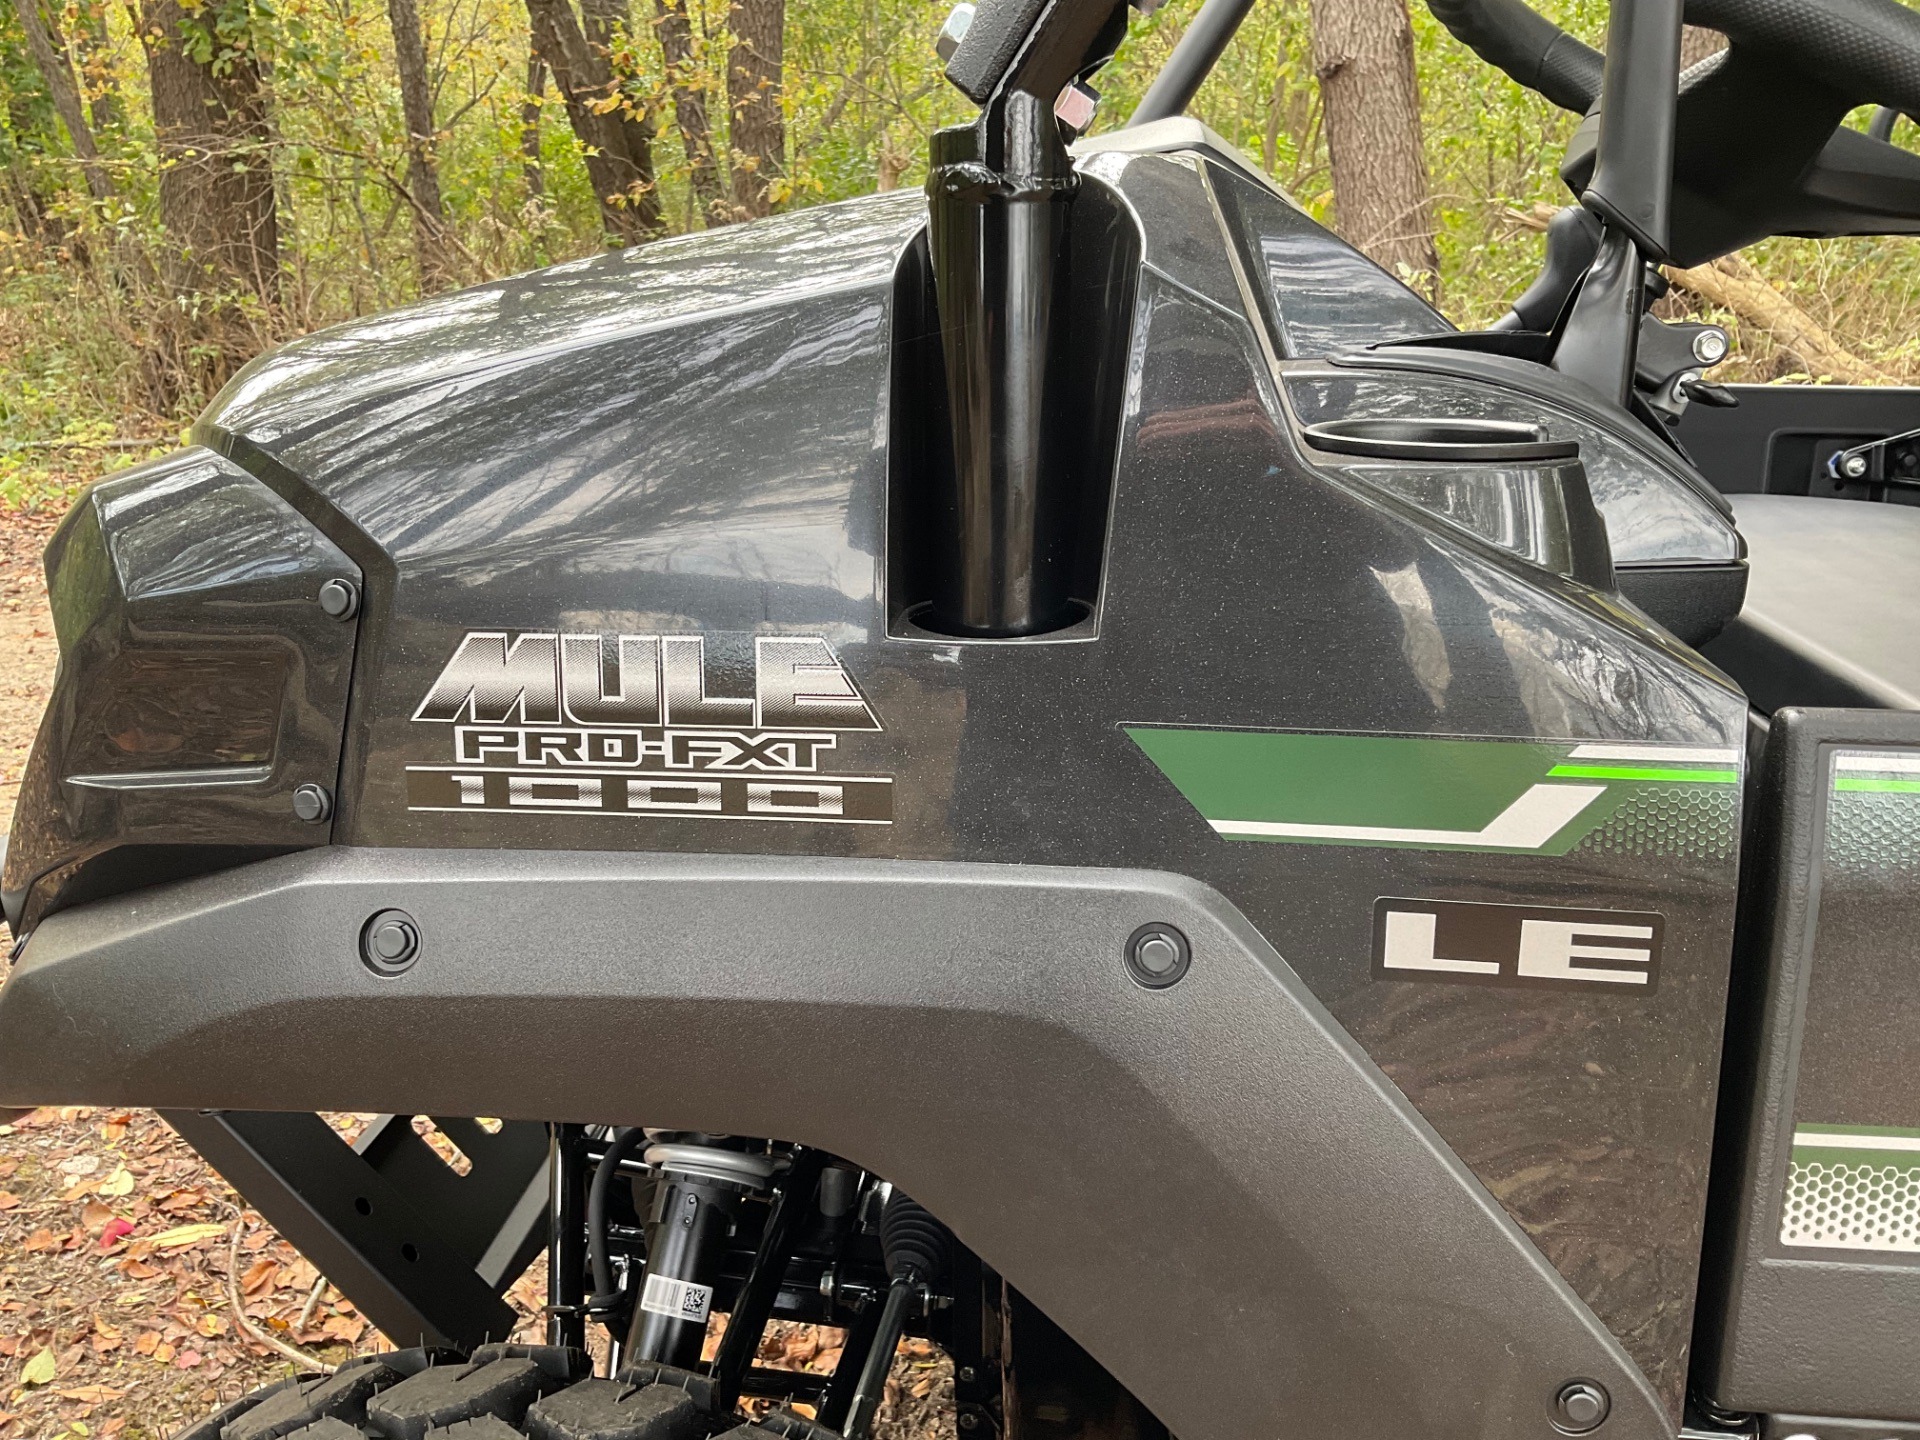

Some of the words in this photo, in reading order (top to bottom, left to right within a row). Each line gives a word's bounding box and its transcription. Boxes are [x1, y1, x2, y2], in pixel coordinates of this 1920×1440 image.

[411, 632, 883, 731] MULE
[455, 726, 836, 771] PRO-FXT
[451, 775, 843, 815] 1000
[1384, 911, 1653, 984] LE
